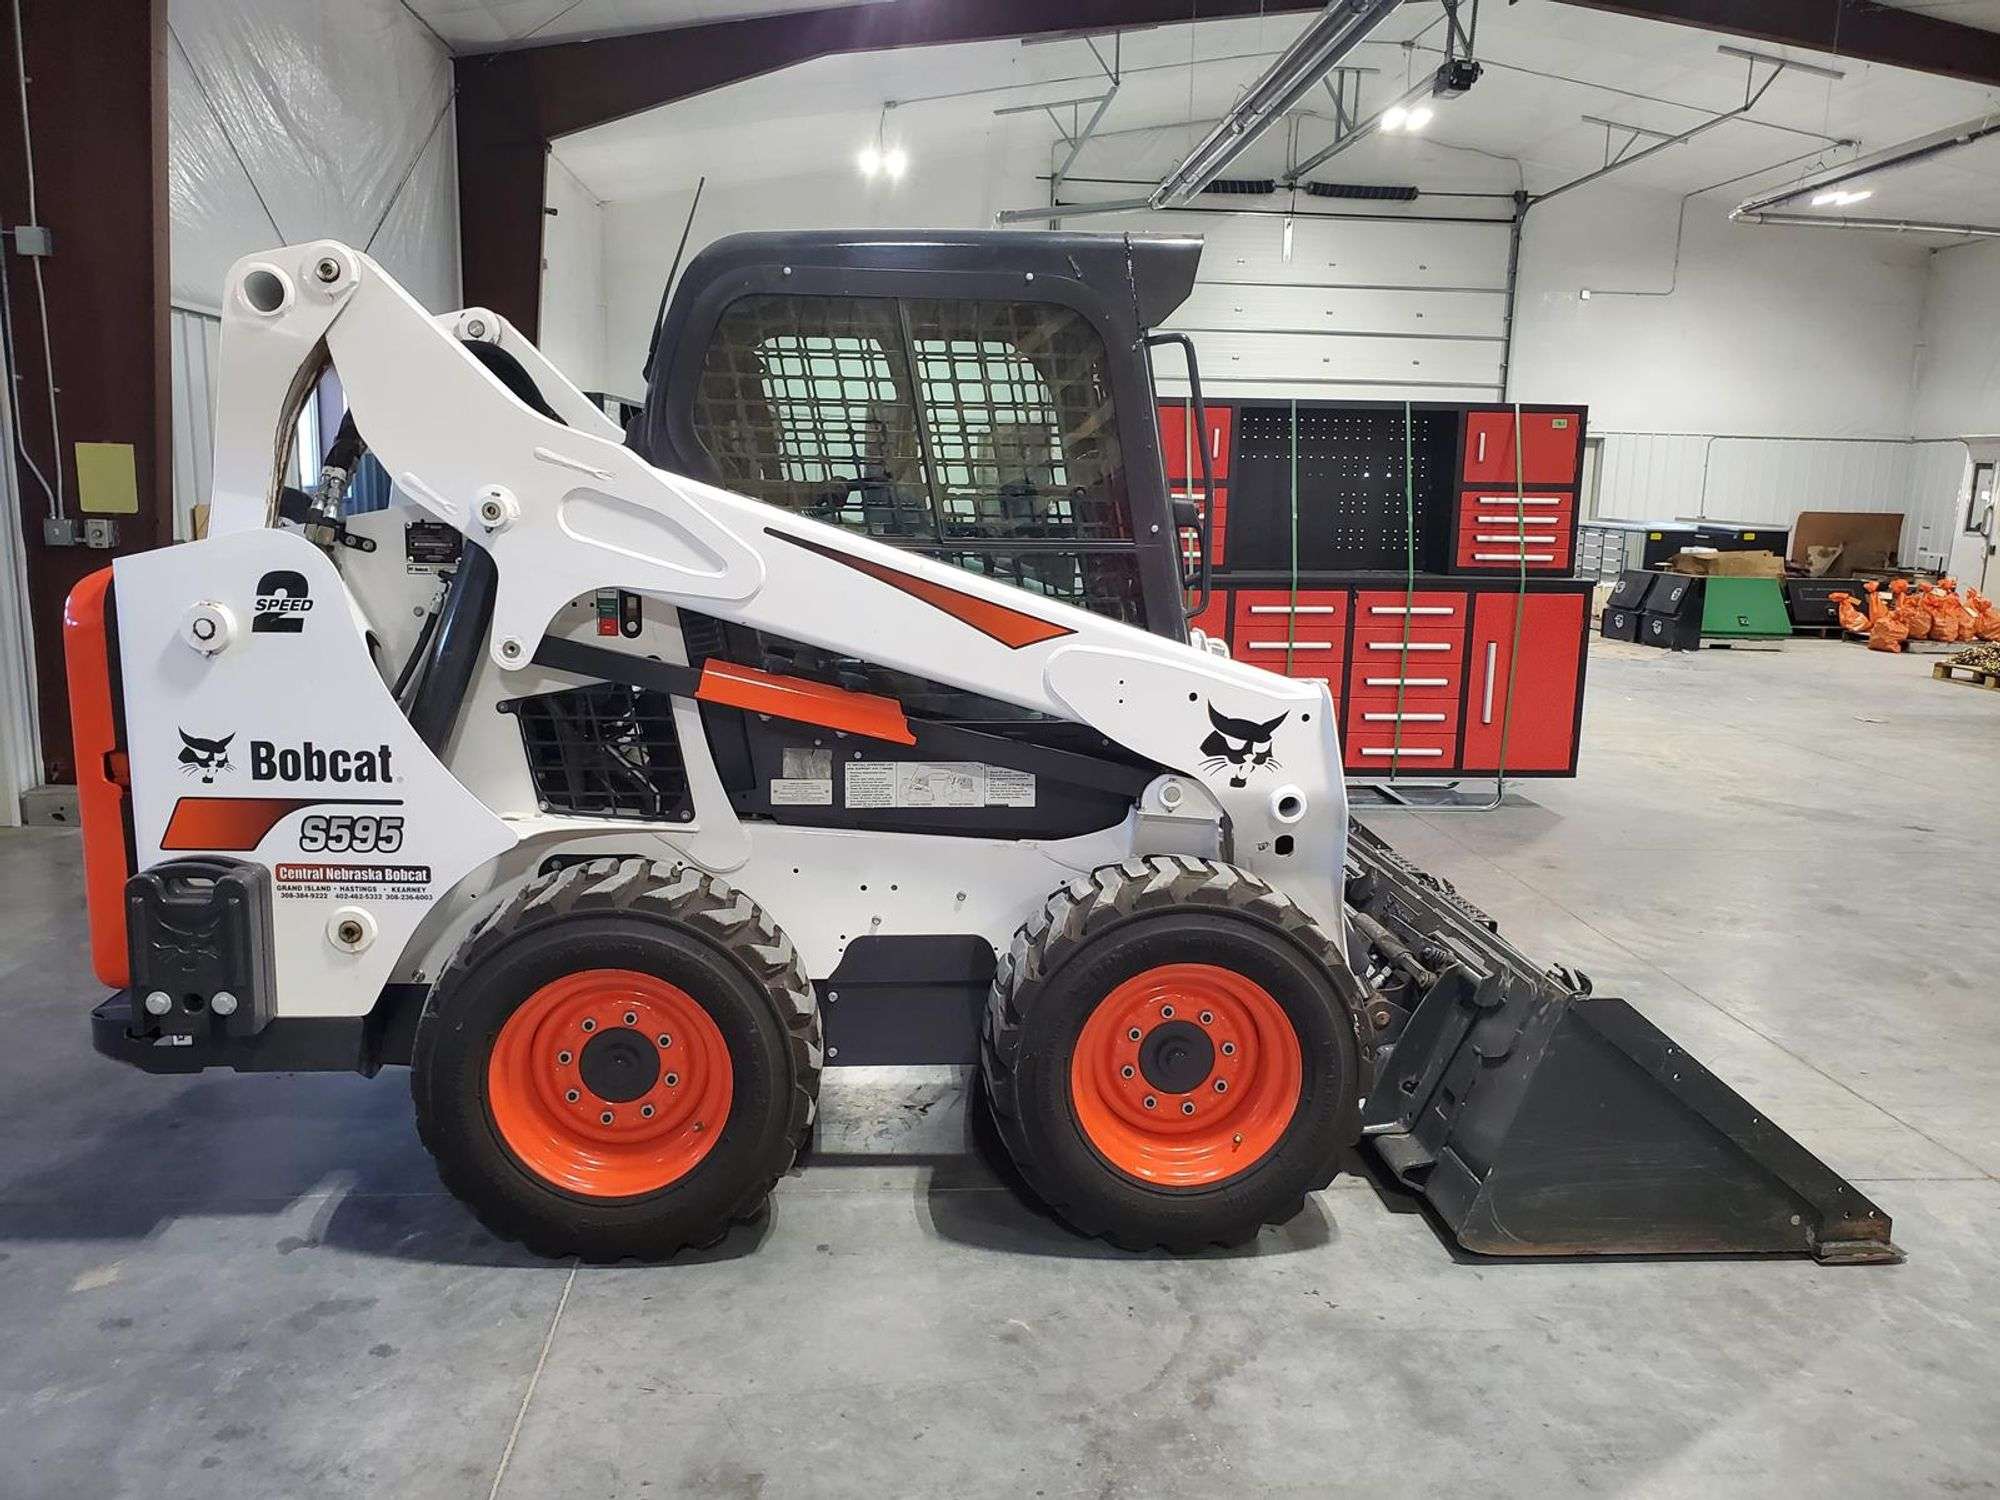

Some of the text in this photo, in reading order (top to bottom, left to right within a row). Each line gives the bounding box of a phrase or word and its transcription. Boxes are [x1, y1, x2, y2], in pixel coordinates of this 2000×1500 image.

[252, 570, 309, 633] 2
[254, 598, 314, 611] SPEED
[250, 740, 393, 783] Bobcat
[299, 815, 405, 854] S595
[279, 866, 427, 882] Central Nebraska Bobcat
[276, 884, 303, 892] GRAND
[391, 886, 427, 894] KEARNEY
